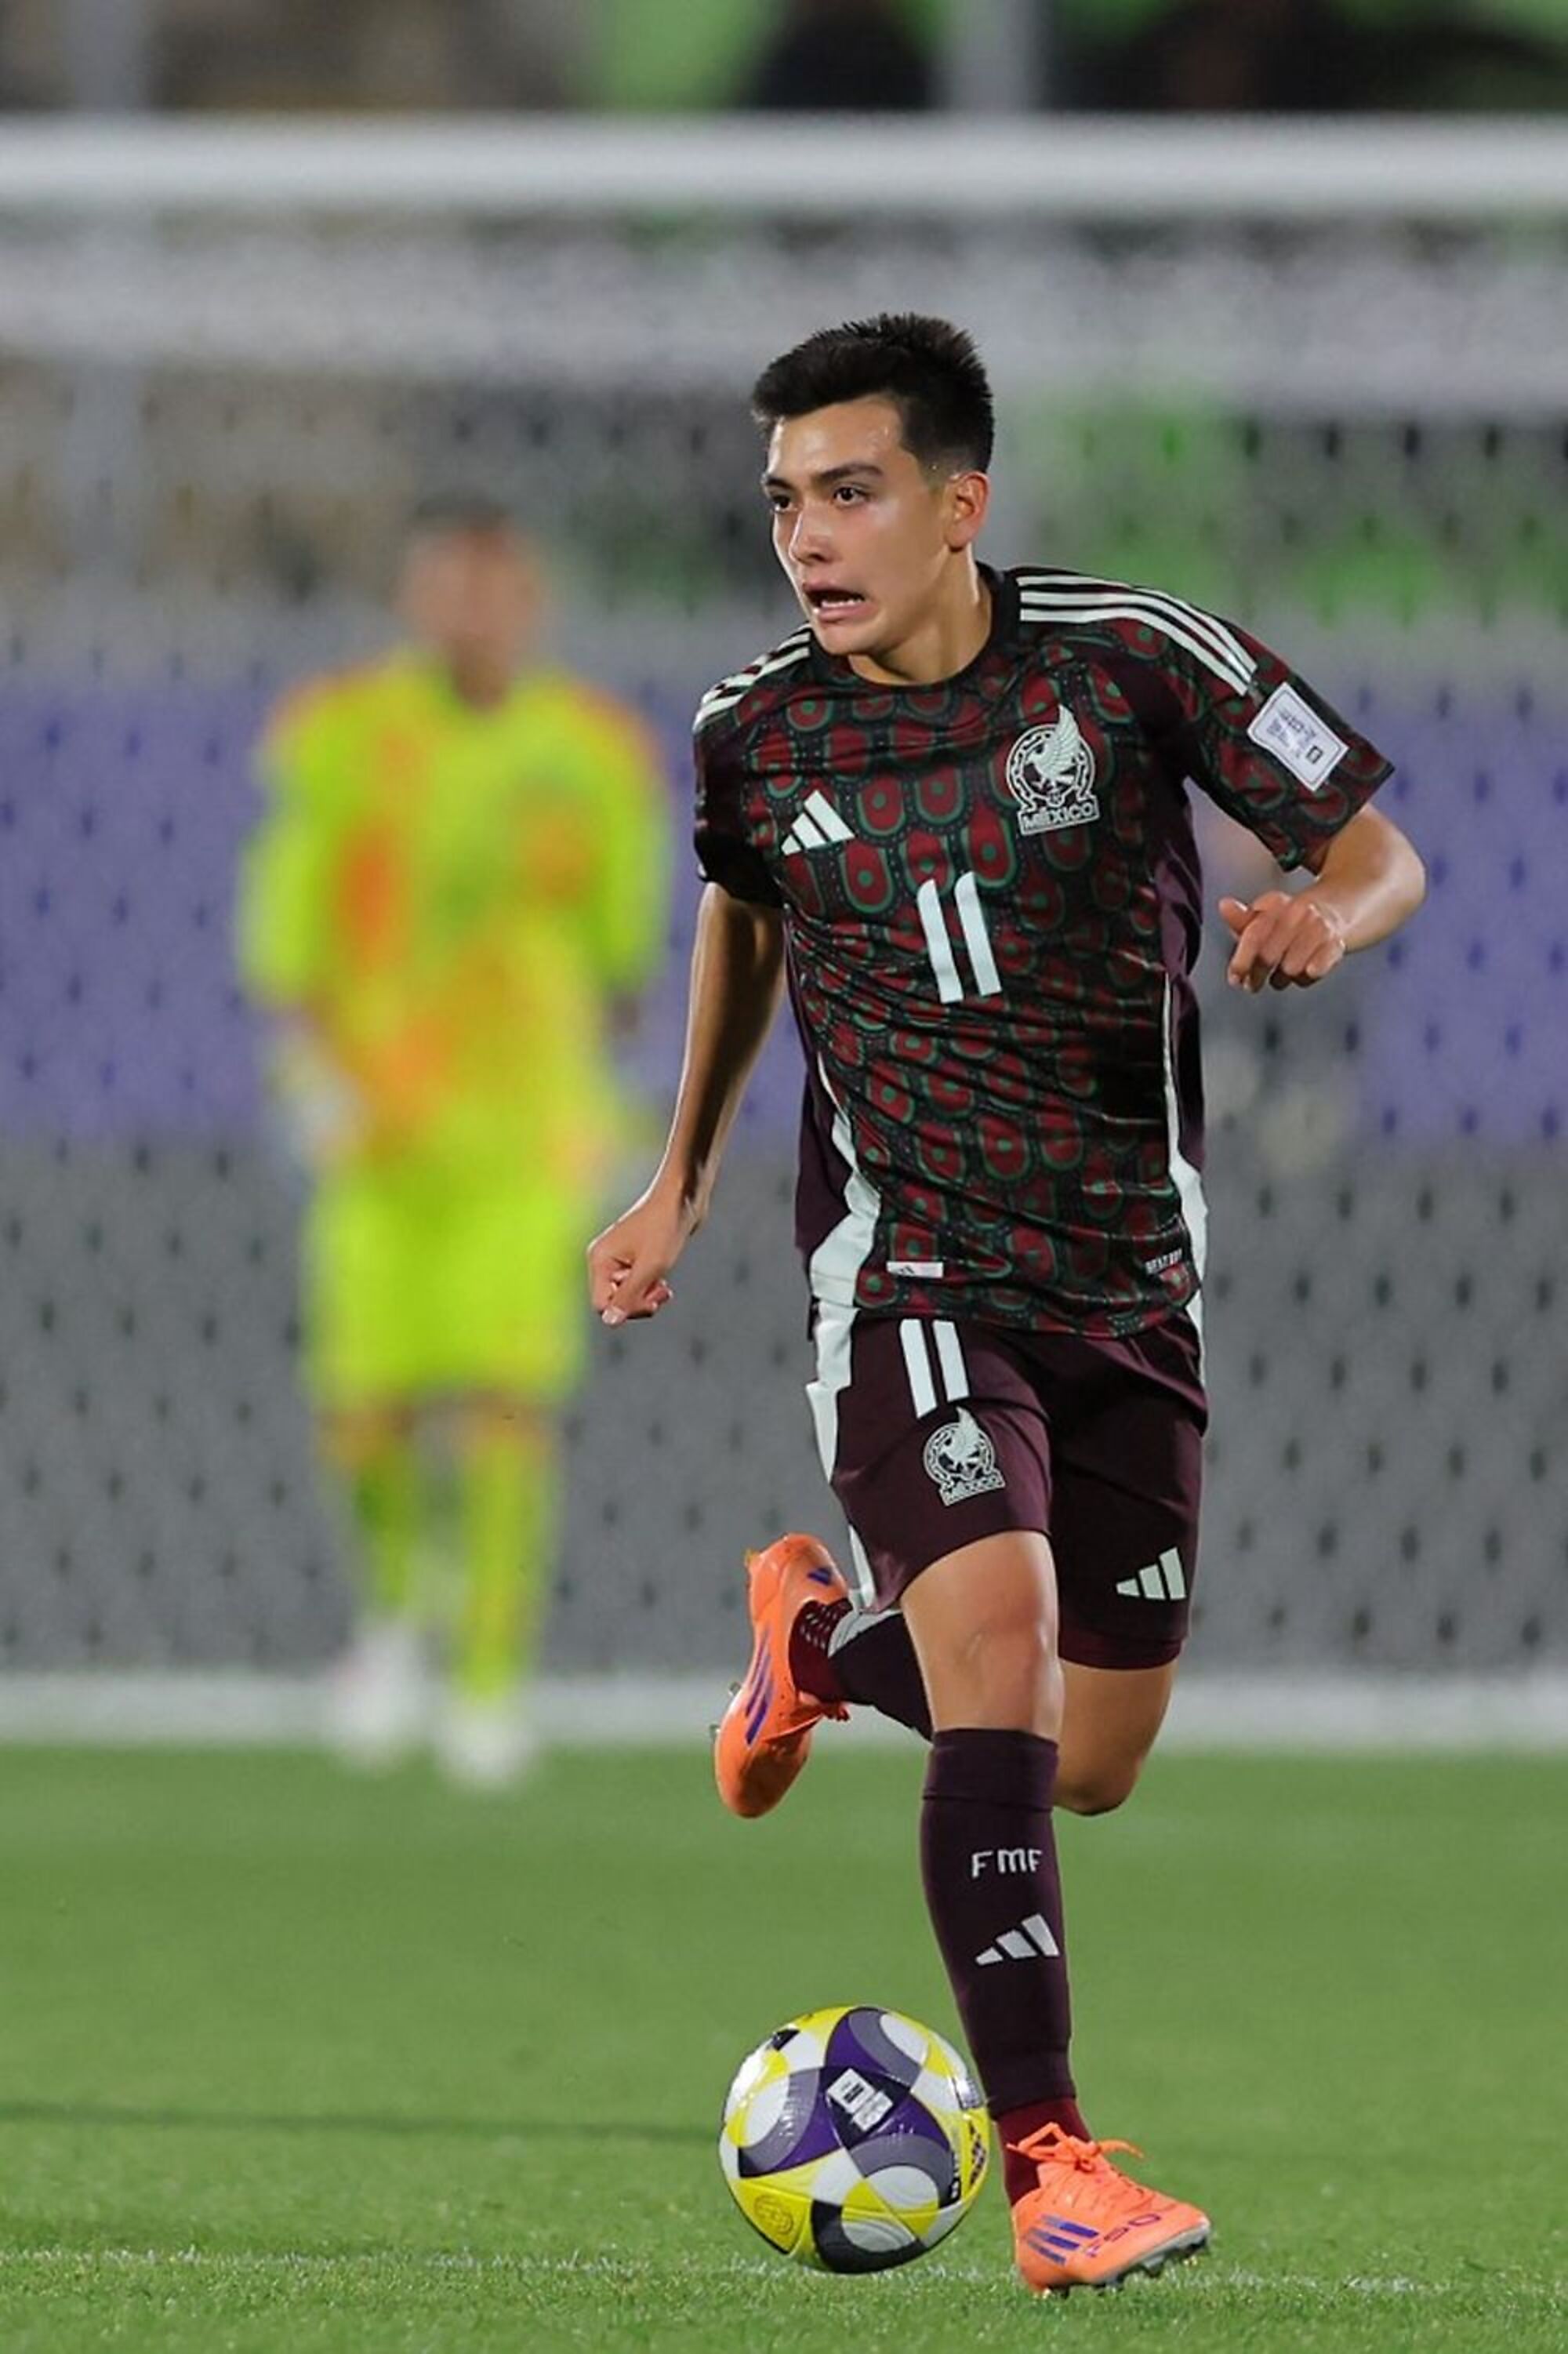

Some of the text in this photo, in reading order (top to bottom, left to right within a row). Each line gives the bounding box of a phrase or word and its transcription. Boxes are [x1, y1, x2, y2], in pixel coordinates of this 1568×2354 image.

[917, 871, 1002, 1003] 11
[899, 1319, 970, 1419] 11
[971, 1848, 1043, 1878] FMF
